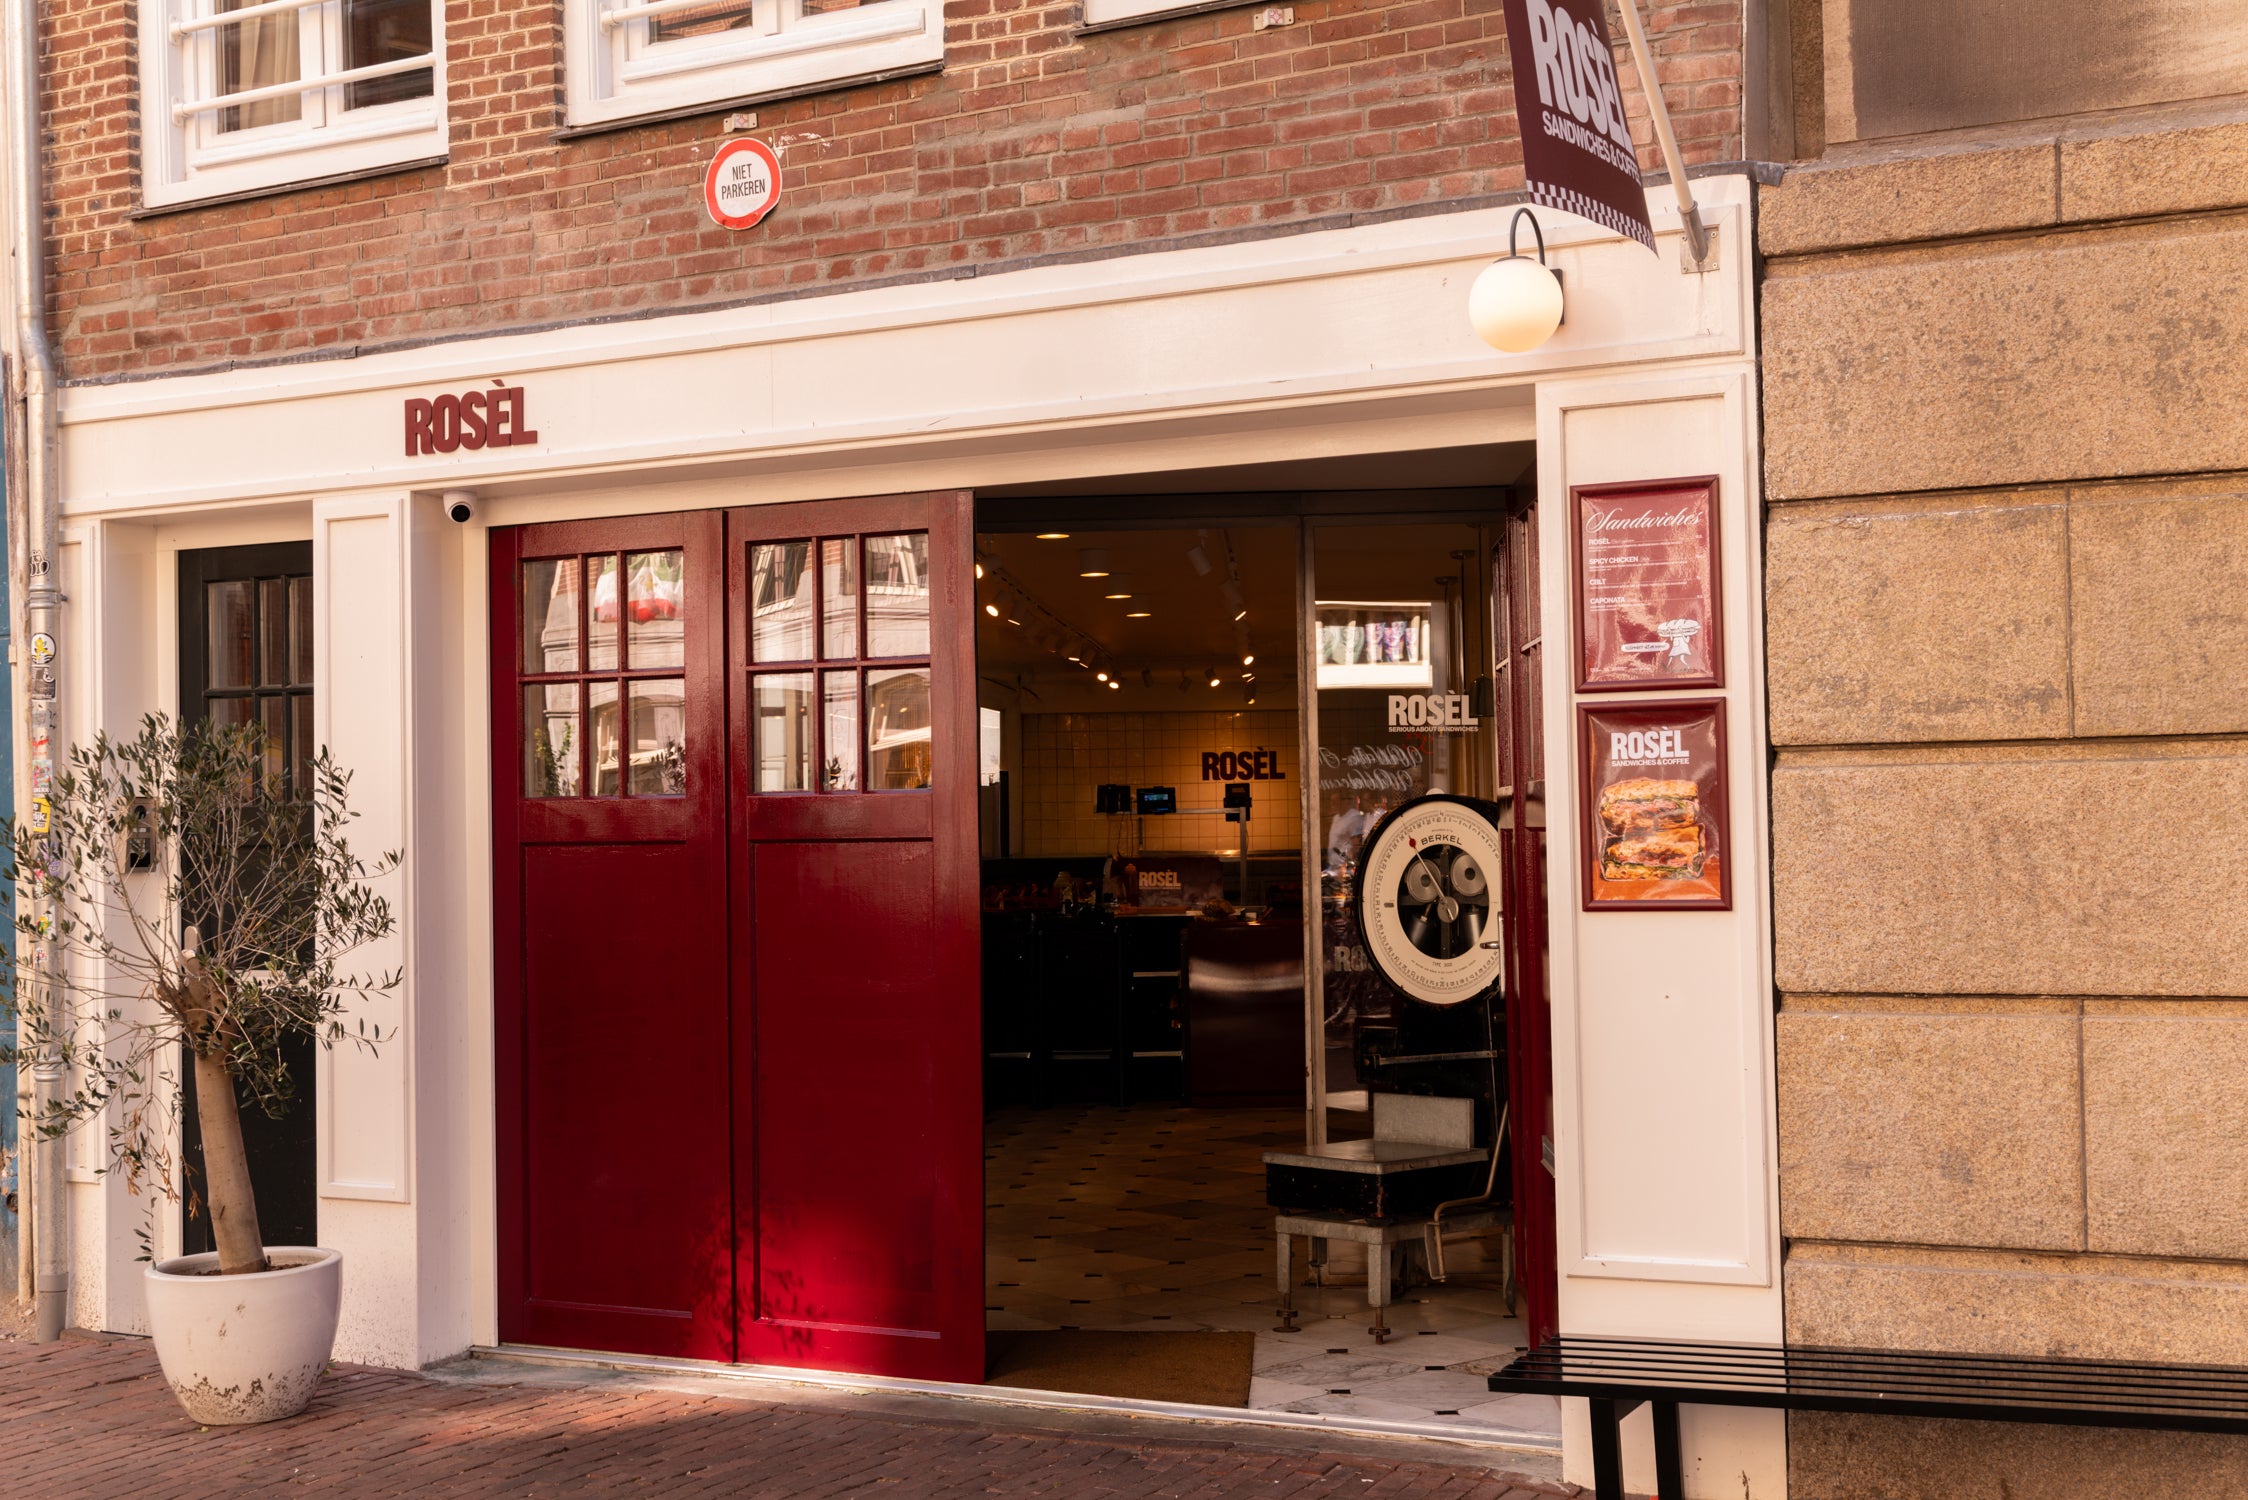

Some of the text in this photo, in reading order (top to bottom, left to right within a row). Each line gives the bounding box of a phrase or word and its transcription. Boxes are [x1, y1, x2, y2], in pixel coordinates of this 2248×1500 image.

[1525, 0, 1636, 160] ROSÈL
[1542, 110, 1611, 163] SANDWICHES
[732, 163, 752, 181] NIET
[721, 178, 766, 200] PARKEREN
[404, 379, 538, 456] ROSÈL
[1586, 507, 1704, 534] Sandwiches
[1588, 557, 1608, 565] SPICY
[1609, 556, 1639, 564] CHICKEN
[1589, 597, 1626, 605] CAPONATA
[1388, 689, 1478, 726] ROSÈL
[1611, 727, 1690, 760] ROSÈL
[1201, 747, 1286, 781] ROSÈL
[1611, 759, 1657, 767] SANDWICHES
[1662, 757, 1690, 766] COFFEE
[1421, 834, 1463, 846] BERKEL
